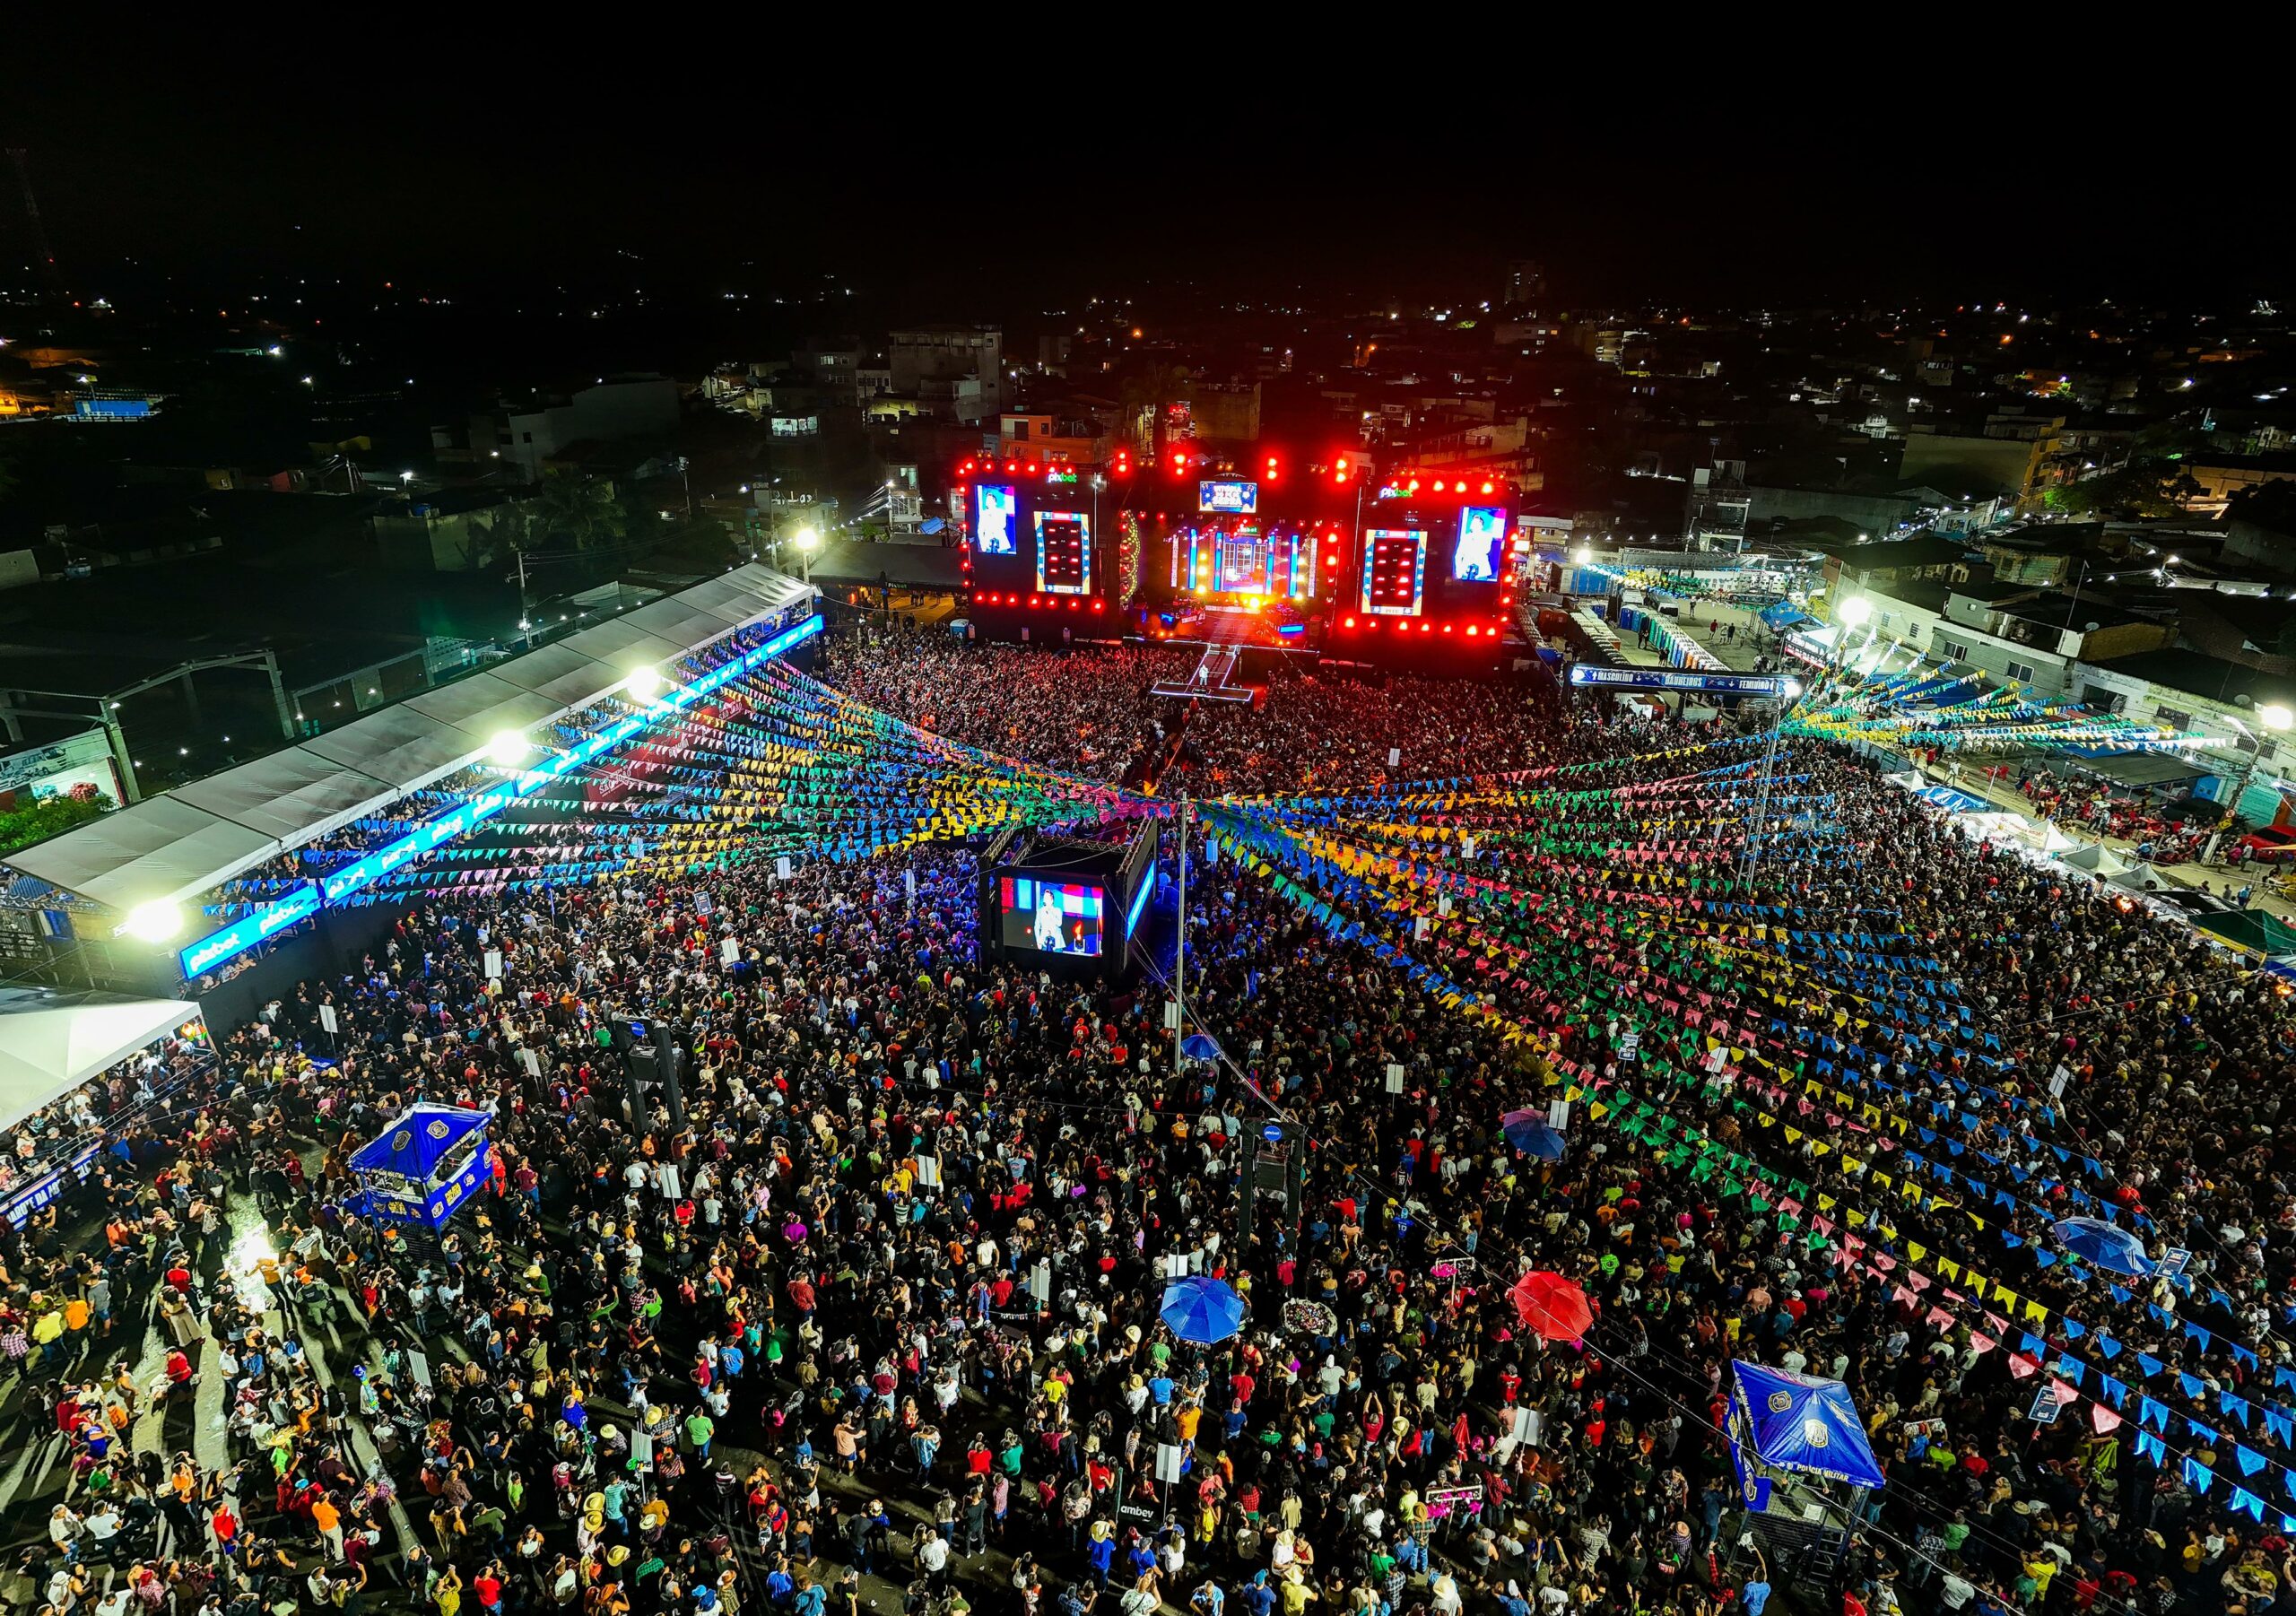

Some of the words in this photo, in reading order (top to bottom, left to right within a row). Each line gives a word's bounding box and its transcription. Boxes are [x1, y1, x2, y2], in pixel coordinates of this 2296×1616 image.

[1048, 473, 1077, 482] pixbet
[1379, 486, 1413, 499] pixbet
[1597, 673, 1633, 682] MASCULINO
[1665, 673, 1702, 687] BANHEIROS
[1739, 679, 1770, 690] FEMININO
[1823, 1469, 1849, 1482] MILITAR
